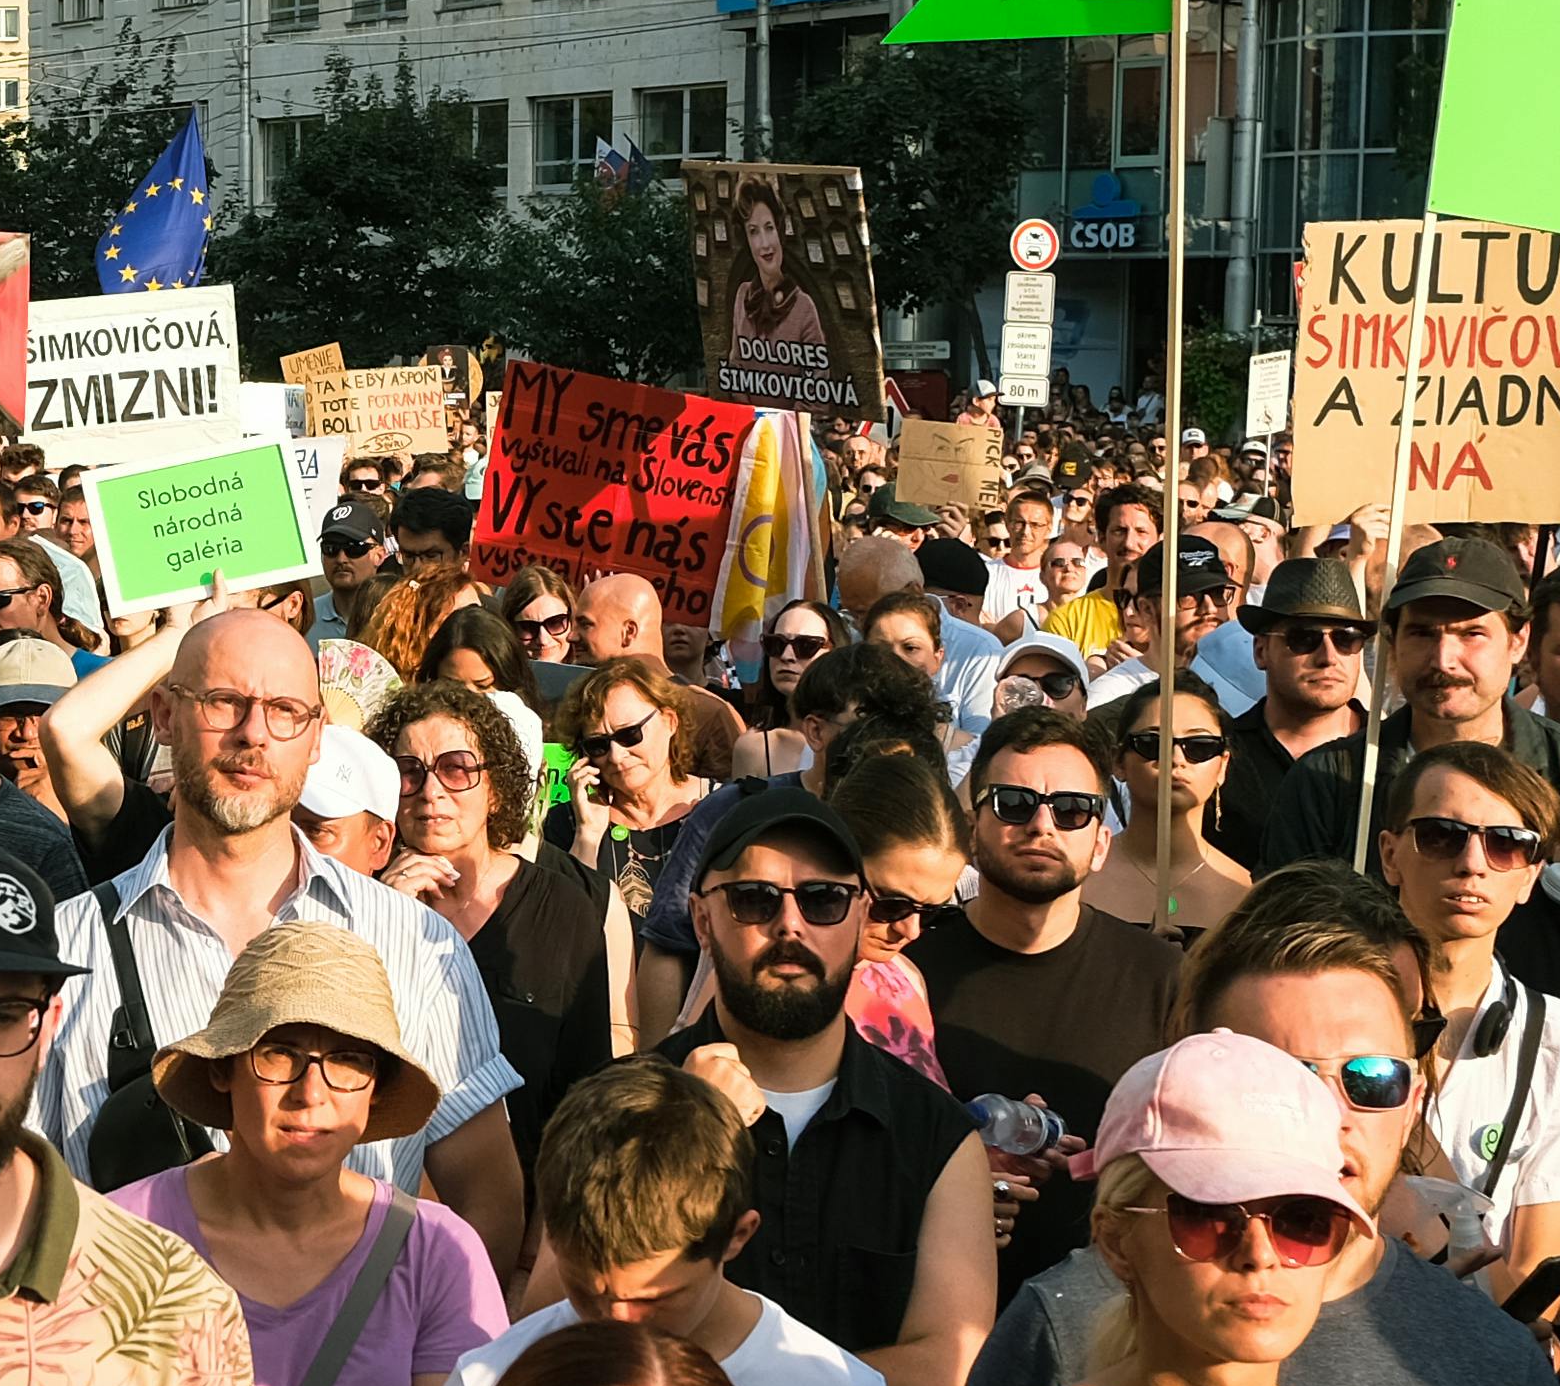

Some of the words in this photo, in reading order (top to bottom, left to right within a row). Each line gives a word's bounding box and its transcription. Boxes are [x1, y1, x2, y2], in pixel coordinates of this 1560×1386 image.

[1070, 219, 1136, 249] ČSOB
[27, 310, 233, 364] ŠIMKOVIČOVÁ,
[738, 336, 830, 370] DOLORES
[288, 348, 334, 375] UMENIE
[28, 364, 219, 432] ZMIZNI!
[314, 378, 336, 395] TA
[341, 372, 385, 390] KEBY
[391, 368, 437, 387] ASPOŇ
[718, 360, 860, 408] ŠIMKOVIČOVÁ
[1009, 384, 1025, 397] 80
[1027, 386, 1039, 397] m
[1313, 375, 1364, 427] A
[320, 397, 360, 413] TOTE
[367, 390, 444, 409] POTRAVINY
[501, 363, 575, 436] MY
[578, 402, 667, 455] sme
[672, 414, 734, 475] vás
[322, 417, 362, 434] BOLI
[368, 409, 443, 431] LACNEJŠE
[500, 435, 591, 476] vyštvali
[594, 459, 628, 486] na
[985, 428, 1001, 468] PICK
[137, 470, 245, 510] Slobodná
[153, 505, 244, 539] národná
[492, 470, 548, 535] VY
[539, 500, 614, 554] ste
[624, 515, 710, 573] nás
[165, 535, 244, 573] galéria
